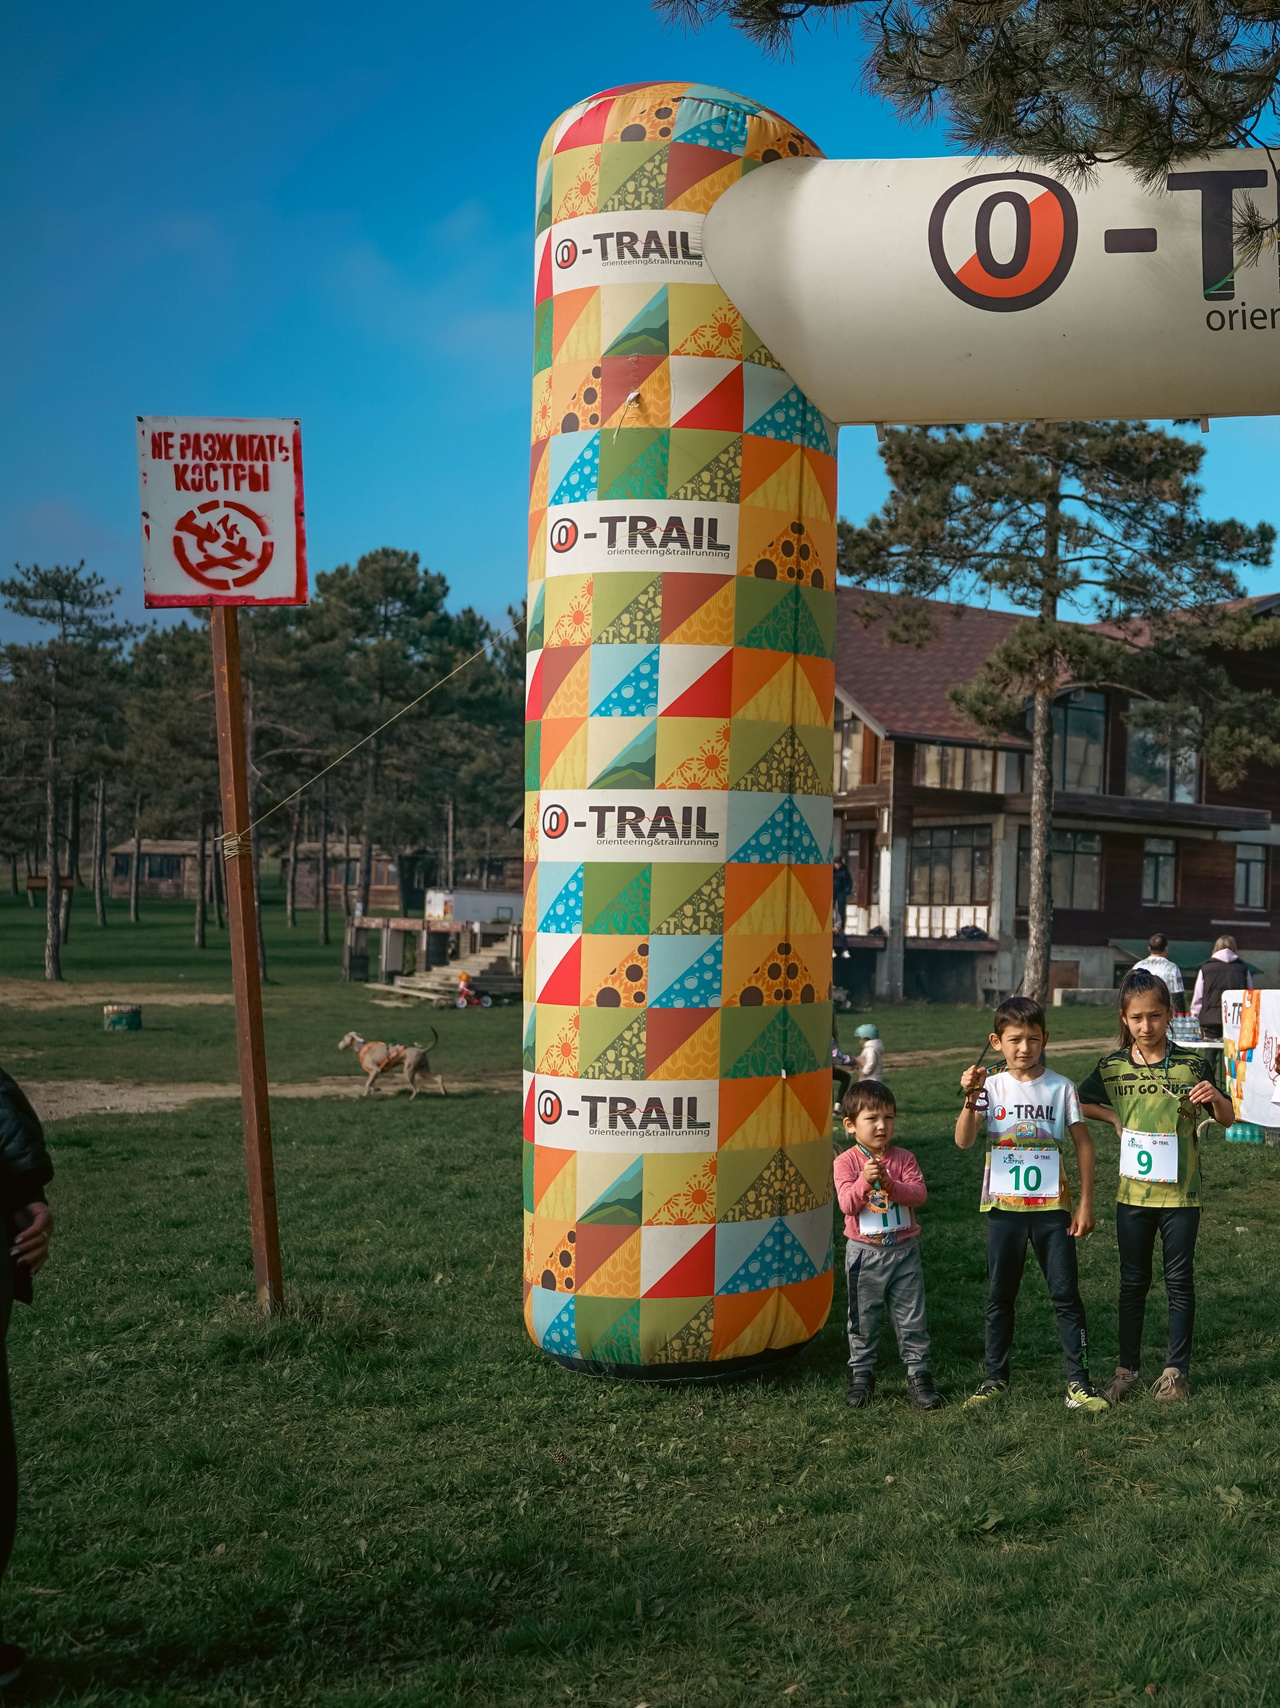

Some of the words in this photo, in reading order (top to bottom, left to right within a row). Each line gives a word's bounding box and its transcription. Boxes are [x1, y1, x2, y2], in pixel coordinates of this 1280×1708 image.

[152, 432, 174, 460] НЕ
[180, 433, 289, 462] РАЗЖИГАТЬ
[174, 463, 269, 492] КОСТРЫ
[607, 548, 730, 560] orienteering&trailrunning
[597, 837, 719, 847] orienteering&trailrunning
[1138, 1084, 1158, 1095] GO
[589, 1128, 710, 1138] orienteering&trailrunning
[1137, 1150, 1153, 1175] 9
[1008, 1165, 1042, 1191] 10
